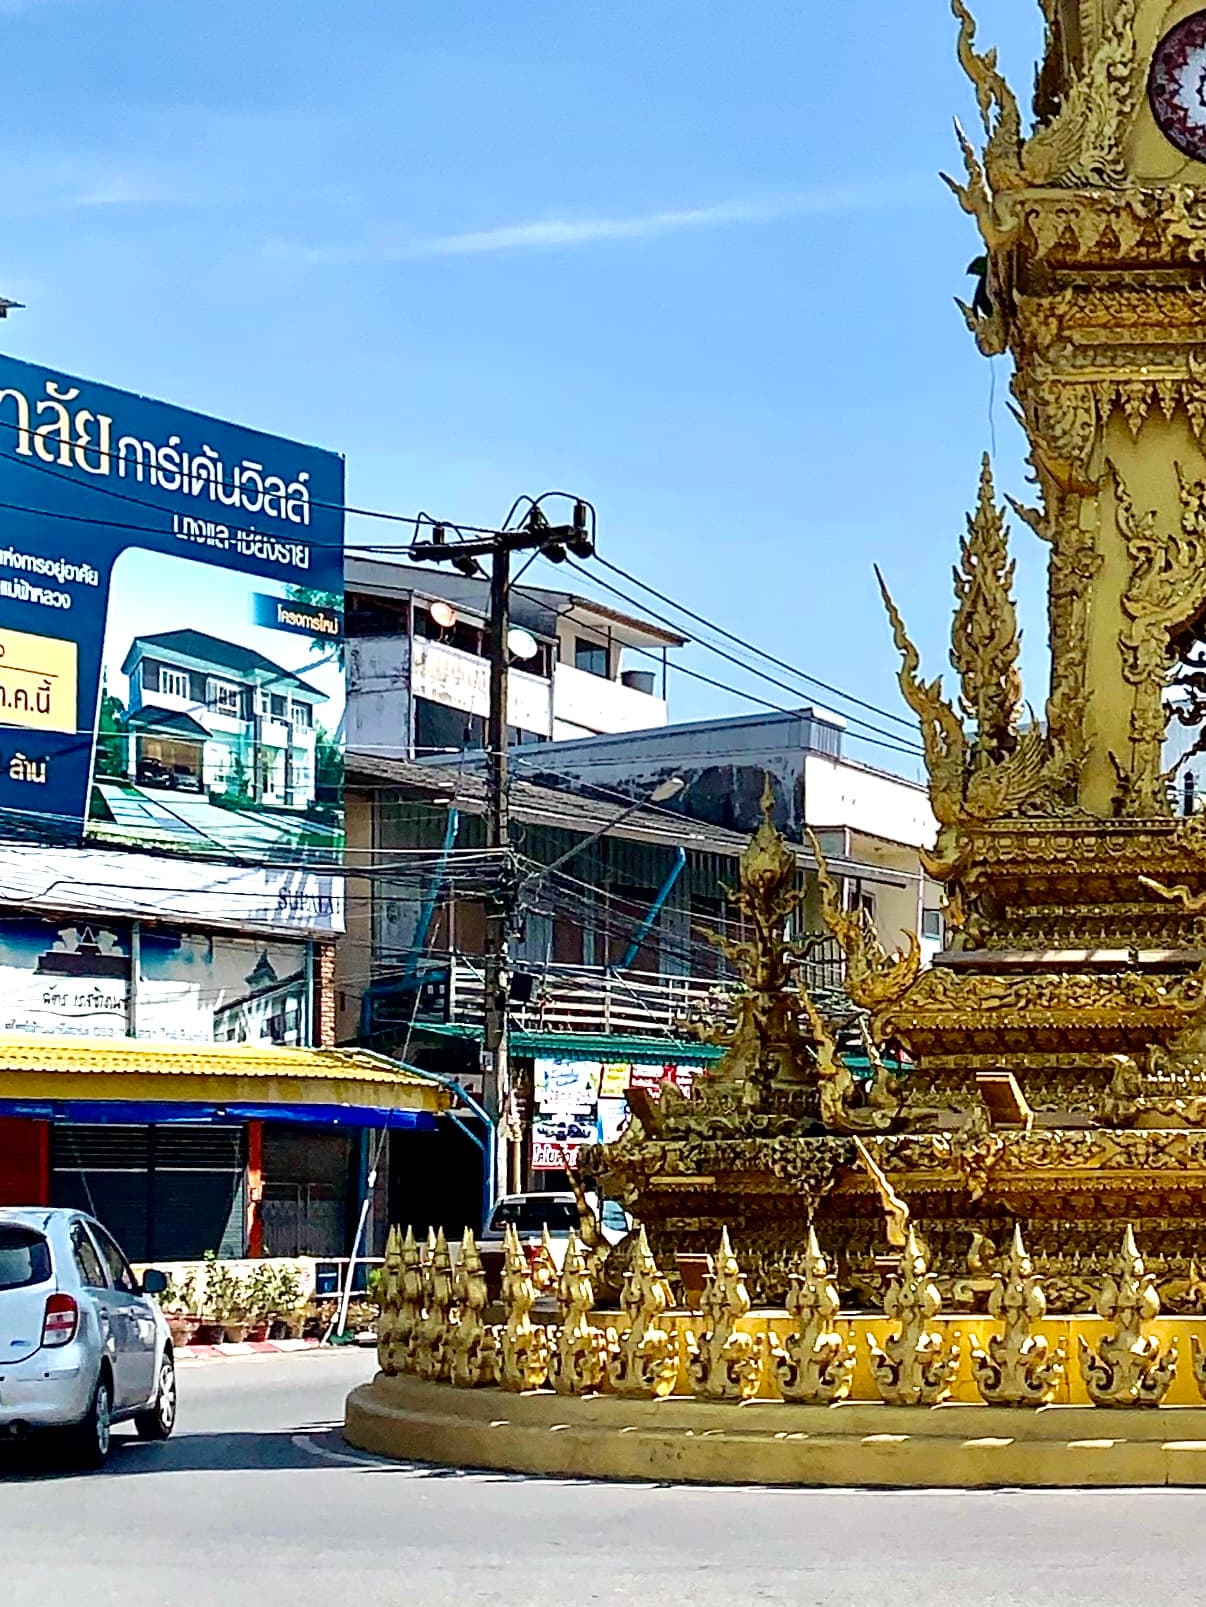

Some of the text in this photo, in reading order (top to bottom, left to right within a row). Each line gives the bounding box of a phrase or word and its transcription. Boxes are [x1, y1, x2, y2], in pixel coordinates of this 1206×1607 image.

[118, 436, 310, 525] การ์เด้นวิลล์
[277, 603, 338, 635] โครงการใหม่
